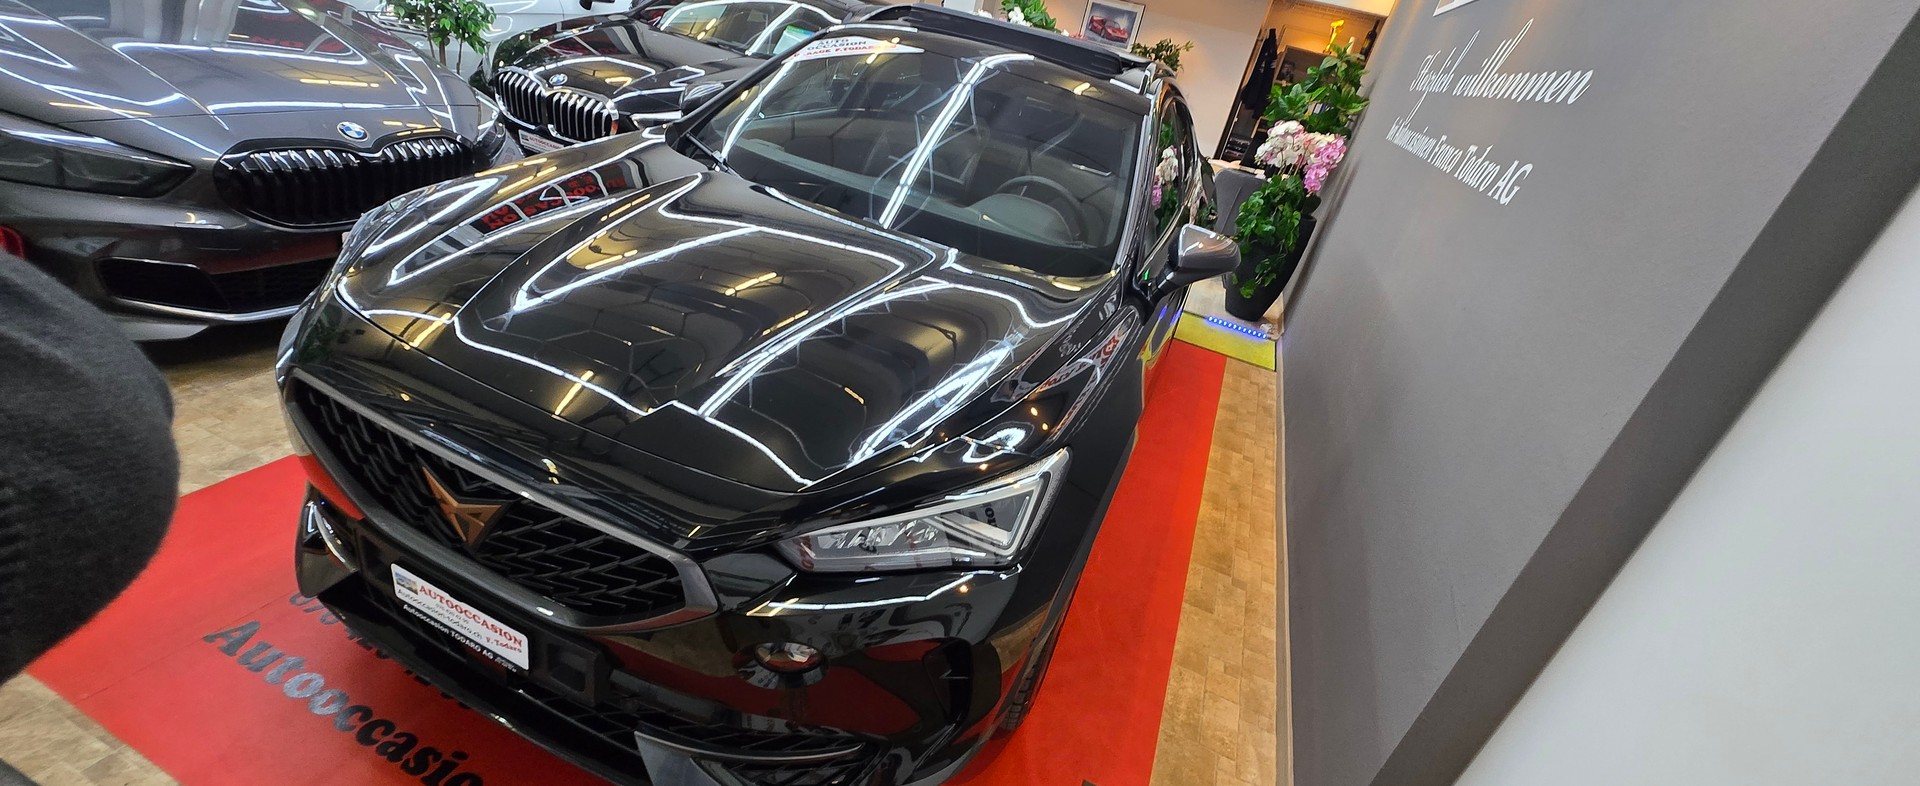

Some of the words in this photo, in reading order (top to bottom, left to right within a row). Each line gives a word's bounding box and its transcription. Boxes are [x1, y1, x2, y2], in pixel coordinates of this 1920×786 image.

[818, 38, 849, 46] AUTO
[1452, 18, 1594, 104] willkommen
[1427, 134, 1463, 173] Franco
[1453, 144, 1501, 192] Todaro
[1487, 159, 1534, 206] AG
[419, 585, 523, 648] AUTOOCCASION
[450, 630, 481, 652] TODARO
[482, 649, 494, 660] AG
